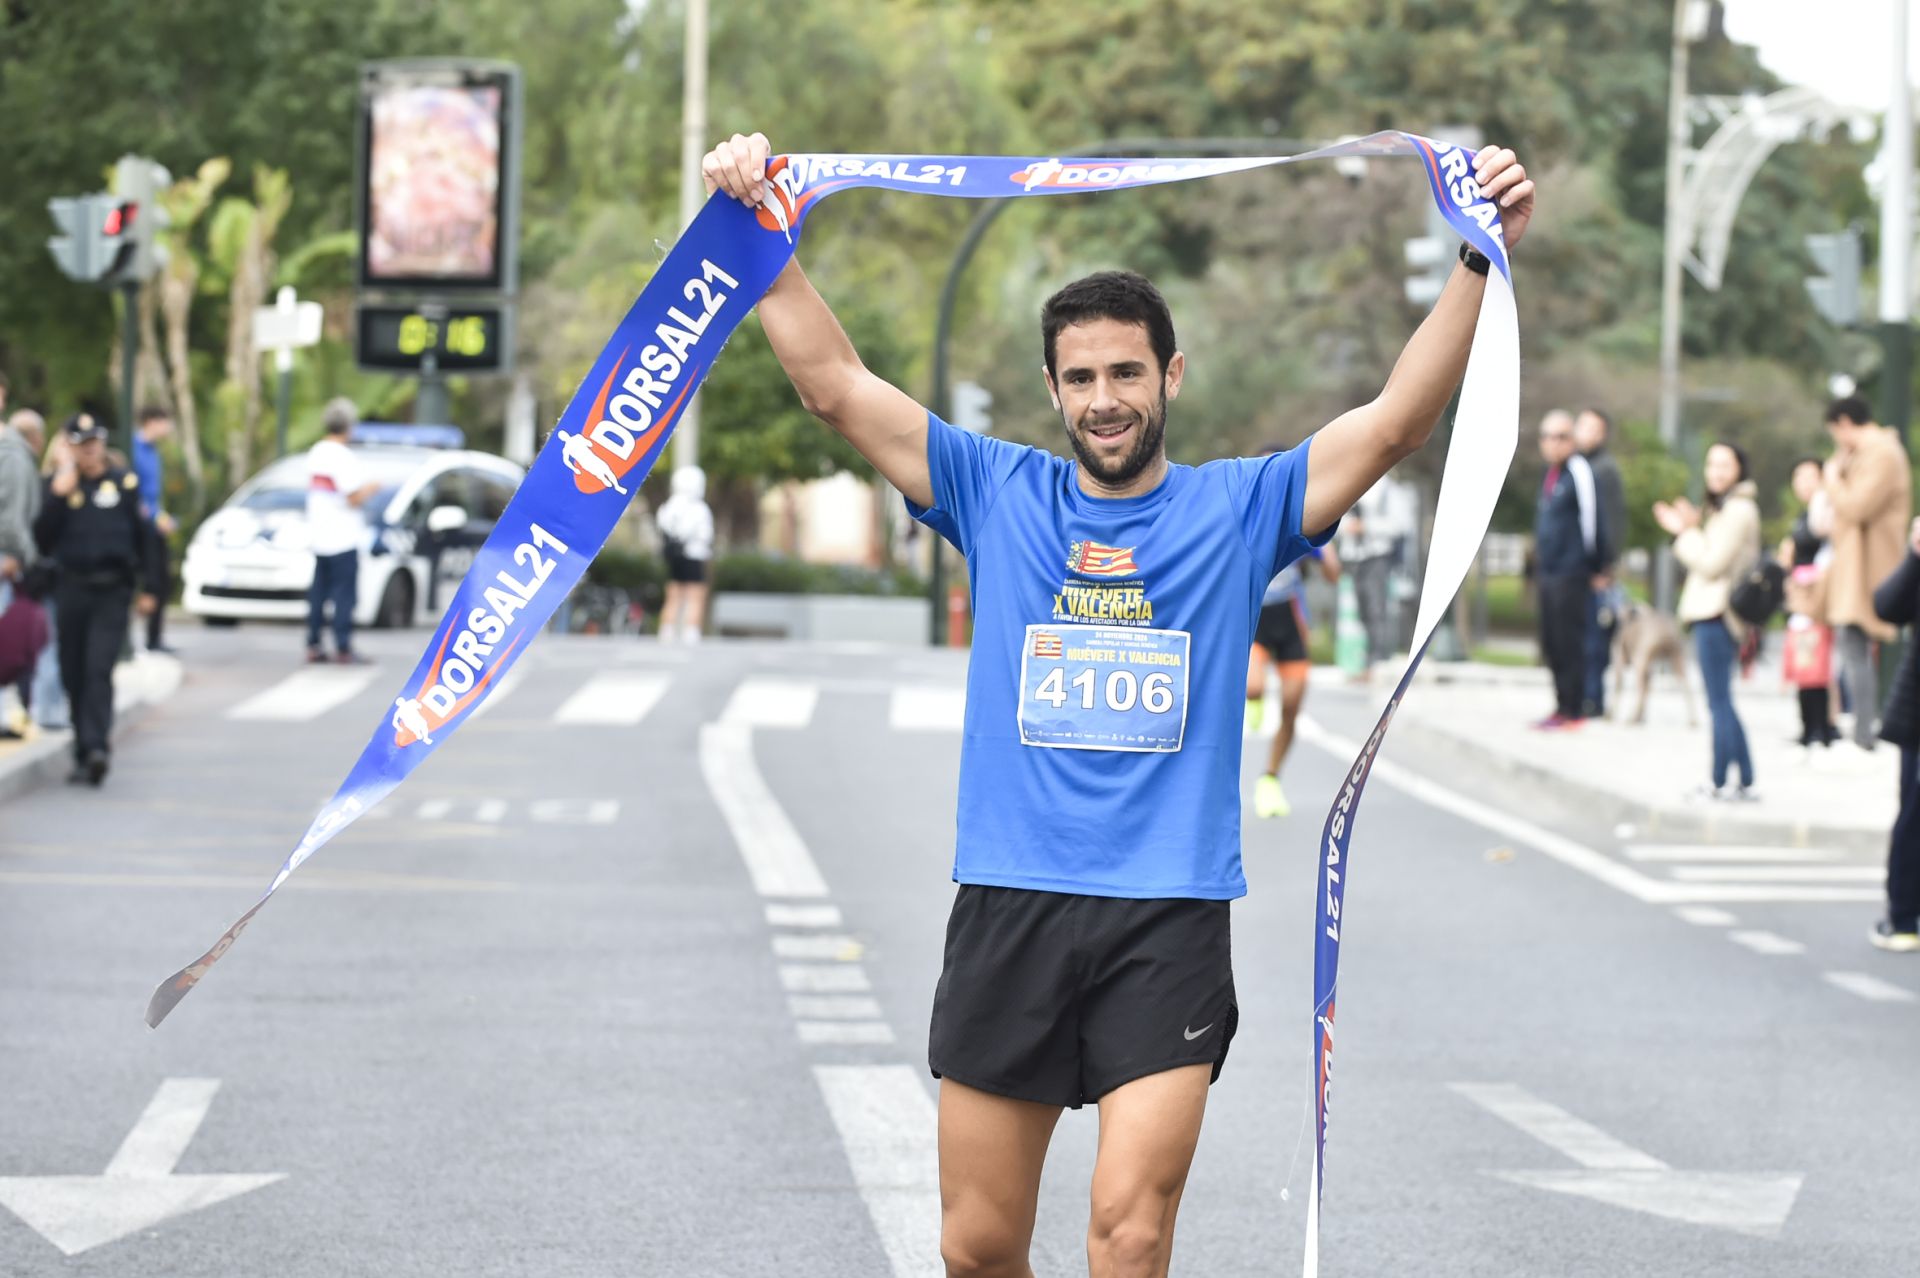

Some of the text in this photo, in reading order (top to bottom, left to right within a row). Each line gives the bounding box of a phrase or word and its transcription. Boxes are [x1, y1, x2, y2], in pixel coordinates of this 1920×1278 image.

[773, 156, 967, 214] DORSAL21
[589, 258, 740, 461] DORSAL21
[421, 522, 569, 719] DORSAL21
[1052, 594, 1153, 620] X VALENCIA
[1062, 585, 1144, 604] MUÉVETE
[1067, 646, 1181, 666] MUÉVETE X VALENCIA
[1034, 667, 1174, 714] 4106
[1326, 728, 1384, 943] DORSAL21
